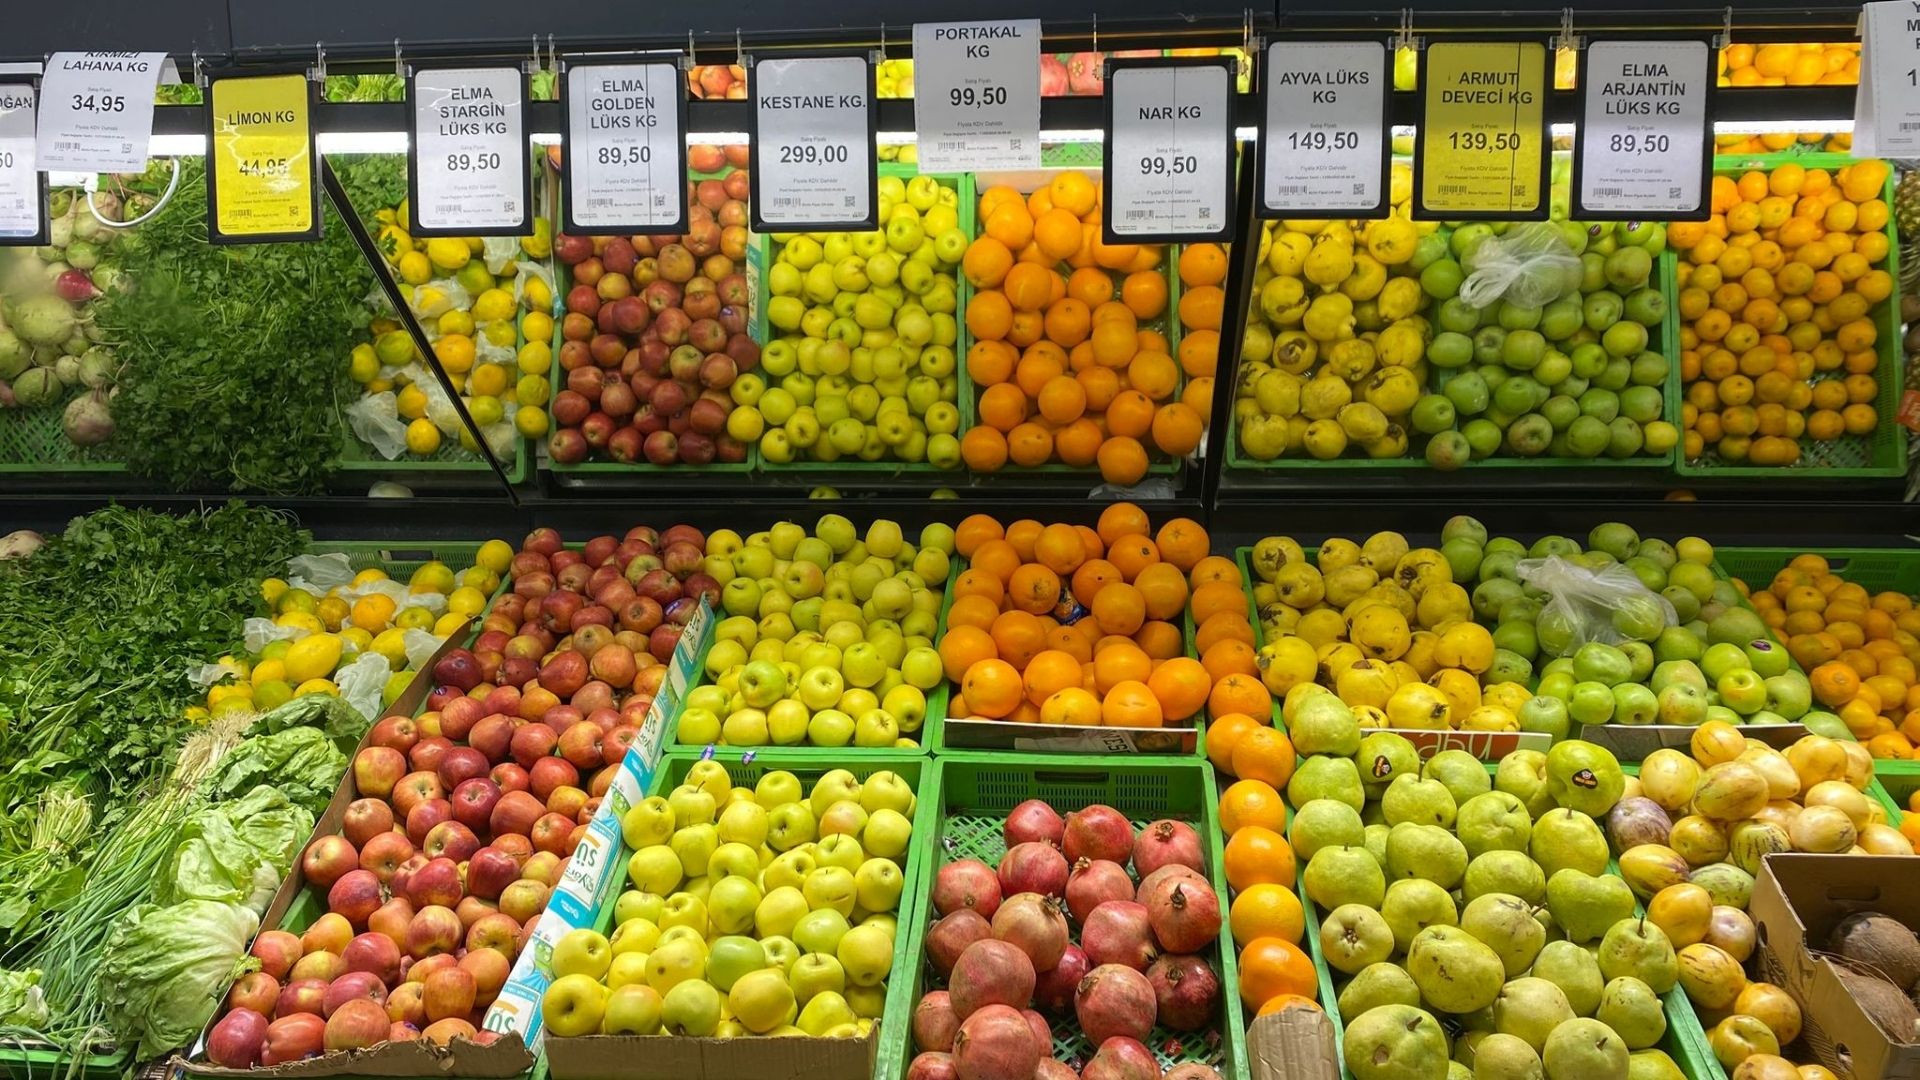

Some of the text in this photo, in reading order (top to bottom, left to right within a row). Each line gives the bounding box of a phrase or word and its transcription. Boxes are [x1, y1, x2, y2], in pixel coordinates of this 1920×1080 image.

[935, 26, 1021, 40] PORTAKAL
[966, 45, 990, 58] KG
[63, 60, 148, 72] LAHANA KG
[1622, 64, 1669, 77] ELMA
[1280, 70, 1369, 85] AYVA LÜKS
[1459, 72, 1518, 85] ARMUT
[602, 80, 644, 92] ELMA
[1602, 80, 1686, 96] ARJANTİN
[451, 88, 493, 100] ELMA
[950, 87, 1007, 108] 99,50
[1313, 90, 1336, 104] KG
[1442, 89, 1532, 104] DEVECİ KG
[72, 94, 124, 114] 34,95
[591, 97, 655, 111] GOLDEN
[761, 95, 866, 109] KESTANE KG.
[1606, 99, 1680, 115] LÜKS KG
[440, 102, 505, 118] STARGİN
[1139, 106, 1201, 120] NAR KG
[229, 110, 295, 126] LİMON KG
[591, 114, 657, 129] LÜKS KG
[440, 122, 507, 136] LÜKS KG
[1288, 132, 1358, 153] 149,50
[1449, 132, 1520, 153] 139,50
[1610, 134, 1670, 155] 89,50
[447, 152, 500, 173] 89,50
[598, 146, 650, 166] 89,50
[780, 146, 848, 166] 299,00
[239, 158, 287, 178] 44,95
[1140, 156, 1197, 177] 99,50
